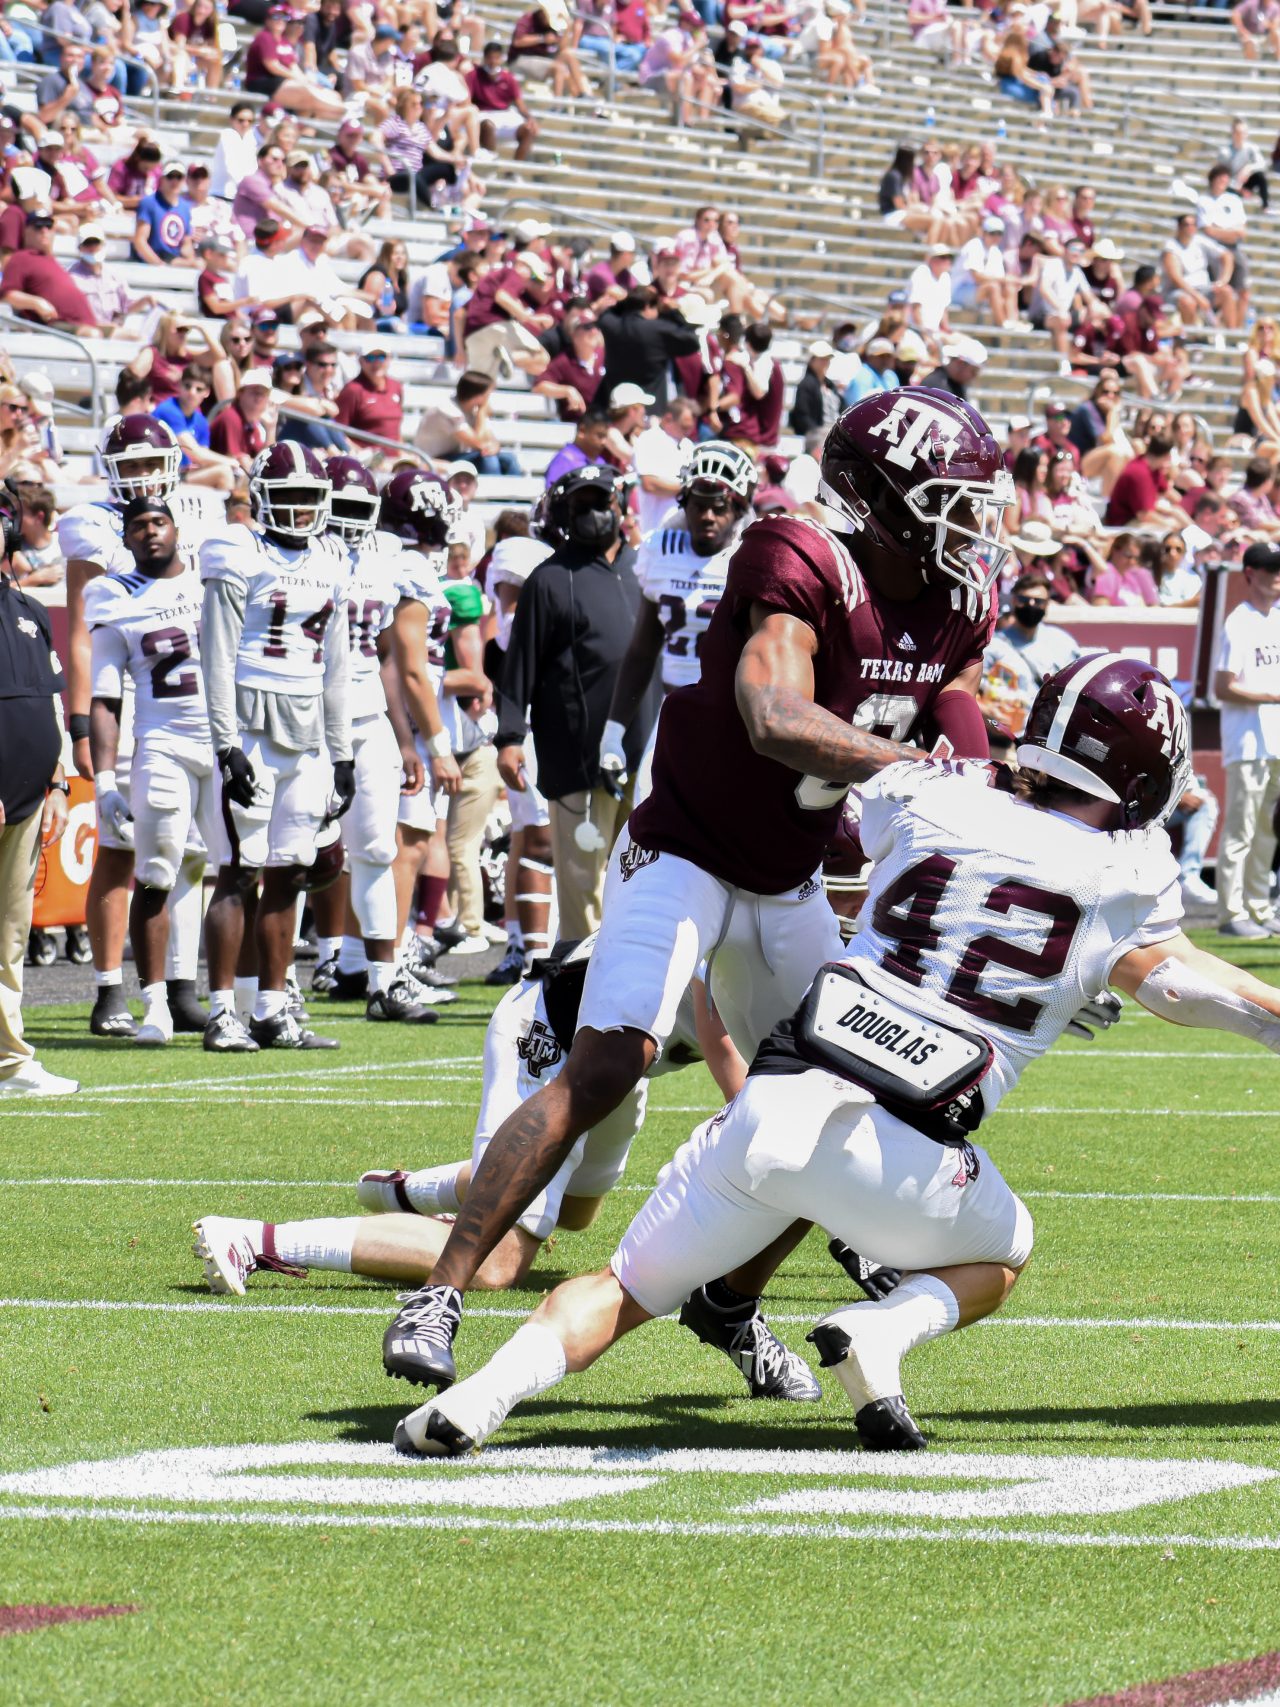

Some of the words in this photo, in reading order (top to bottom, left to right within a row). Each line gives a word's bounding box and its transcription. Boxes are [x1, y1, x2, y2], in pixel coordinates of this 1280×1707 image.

[156, 605, 191, 622] TEXAS
[263, 591, 334, 664] 14
[141, 626, 201, 699] 2
[860, 658, 914, 683] TEXAS
[916, 662, 945, 683] A&M
[797, 882, 821, 901] adidas
[870, 851, 1086, 1036] 42
[836, 1003, 938, 1066] DOUGLAS
